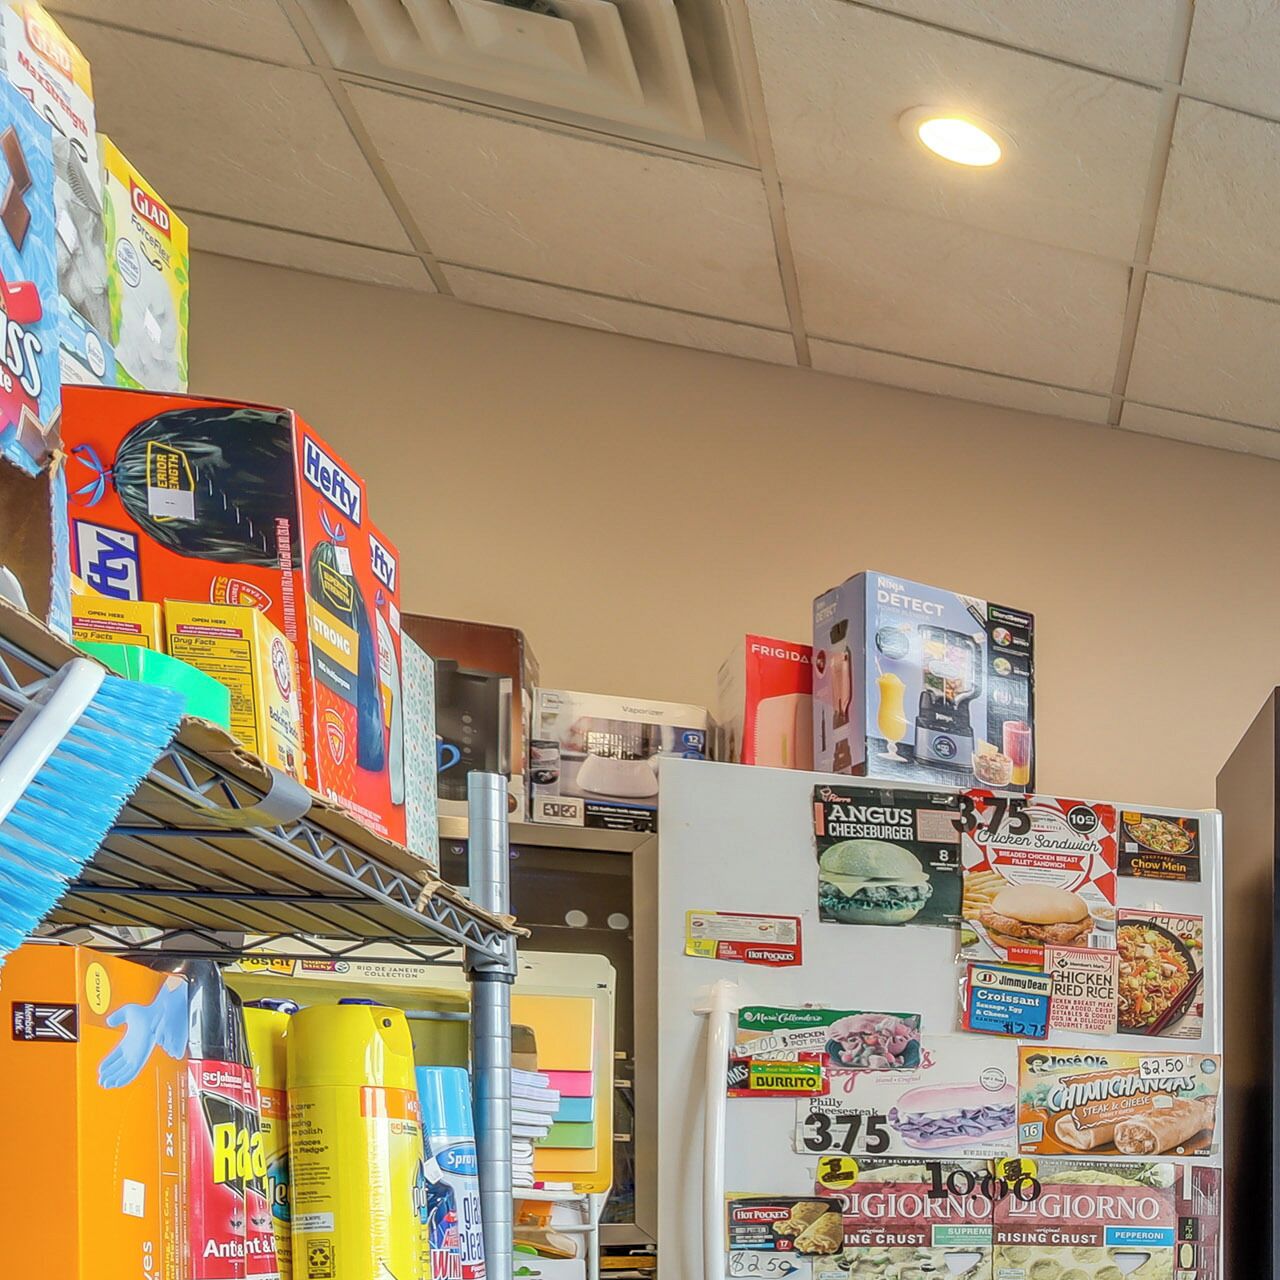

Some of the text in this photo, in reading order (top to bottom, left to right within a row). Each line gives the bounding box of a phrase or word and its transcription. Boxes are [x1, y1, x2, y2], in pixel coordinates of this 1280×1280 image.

[133, 186, 170, 231] GLAD
[131, 214, 170, 261] ForceFlex
[306, 438, 360, 525] Hefty
[876, 590, 945, 617] DETECT
[313, 613, 350, 656] STRONG
[622, 705, 664, 718] Vaporizer
[828, 804, 913, 826] ANGUS
[952, 797, 1031, 836] 3.75
[829, 822, 914, 841] CHEESEBURGER
[977, 828, 1101, 853] Chicken Sandwich
[1034, 860, 1066, 869] SANDWICH
[1130, 858, 1187, 872] Chow Mein
[999, 975, 1048, 991] Jimmy Dean
[1051, 970, 1113, 986] CHICKEN
[92, 969, 101, 1009] LARGE
[1087, 985, 1115, 999] RICE
[977, 989, 1040, 1006] Croissant
[789, 1029, 825, 1041] CHICKEN
[790, 1036, 827, 1047] POT PIES
[1049, 1054, 1108, 1068] José Olé
[1141, 1058, 1184, 1076] $2.50
[756, 1076, 817, 1088] BURRITO
[809, 1097, 843, 1107] Philly
[1083, 1096, 1151, 1117] STEAK CHEESE
[809, 1106, 878, 1115] Cheesesteak
[803, 1113, 891, 1154] 3.75
[948, 1227, 992, 1236] SUPREME
[998, 1232, 1098, 1244] RISING CRUST
[1115, 1231, 1164, 1240] PEPPERONI
